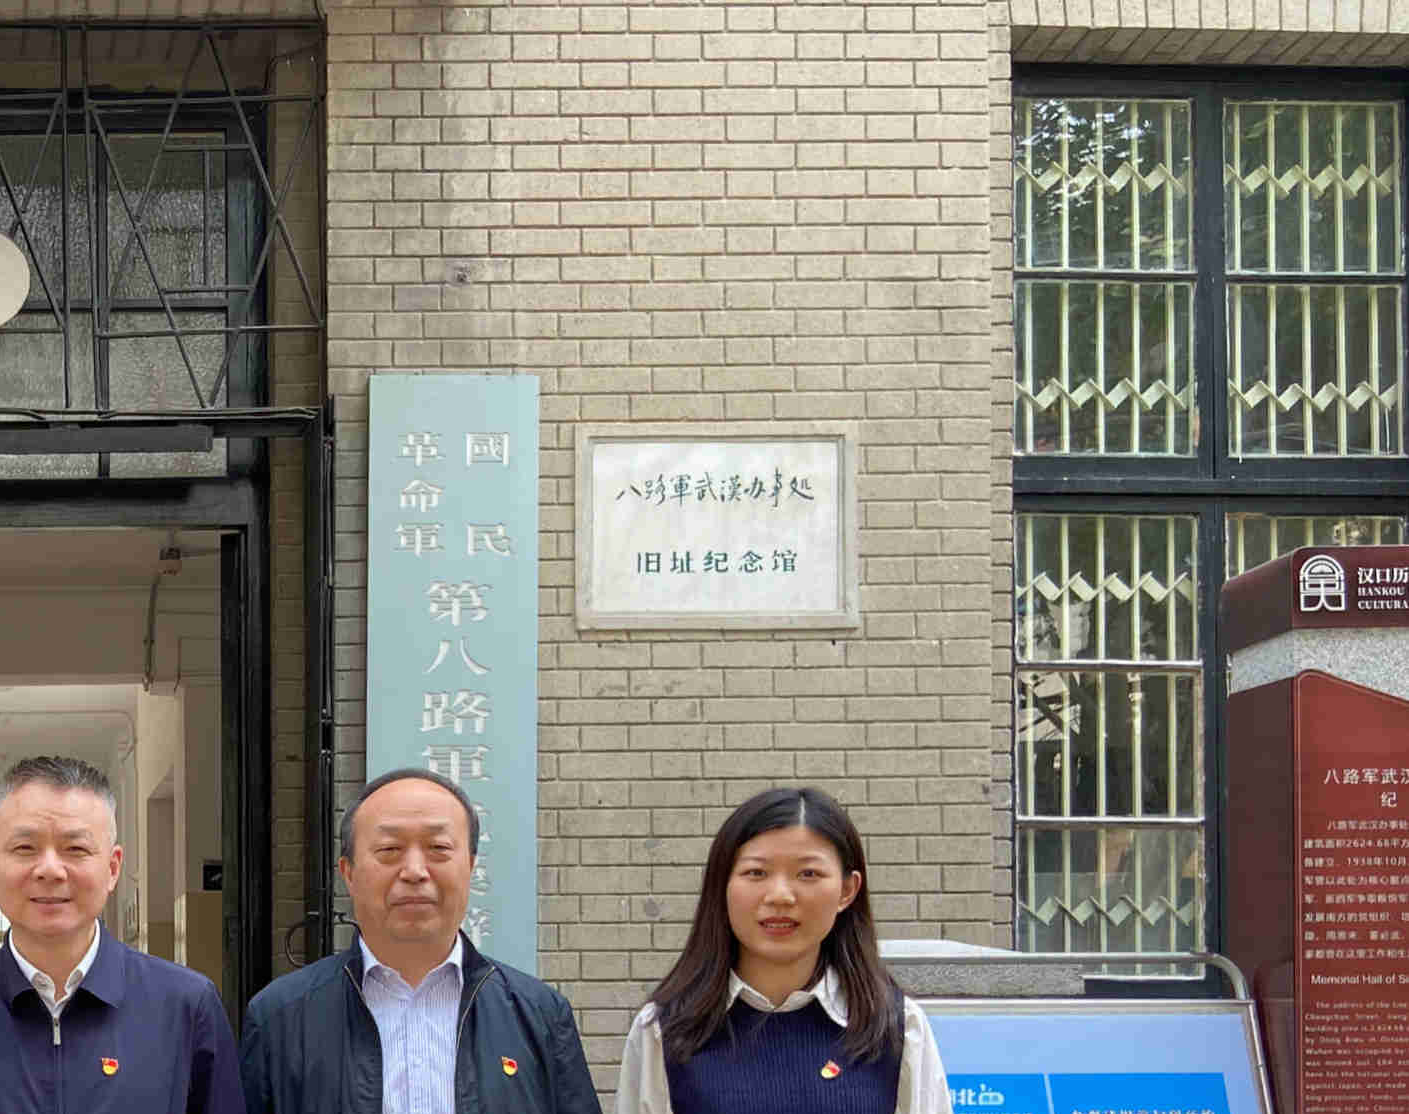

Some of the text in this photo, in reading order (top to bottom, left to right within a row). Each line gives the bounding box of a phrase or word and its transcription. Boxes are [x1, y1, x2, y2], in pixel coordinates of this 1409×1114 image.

[393, 431, 446, 557] 革命軍
[637, 550, 798, 574] 旧址纪念馆
[1358, 567, 1409, 584] 汉口历
[1358, 586, 1406, 597] HANKOU
